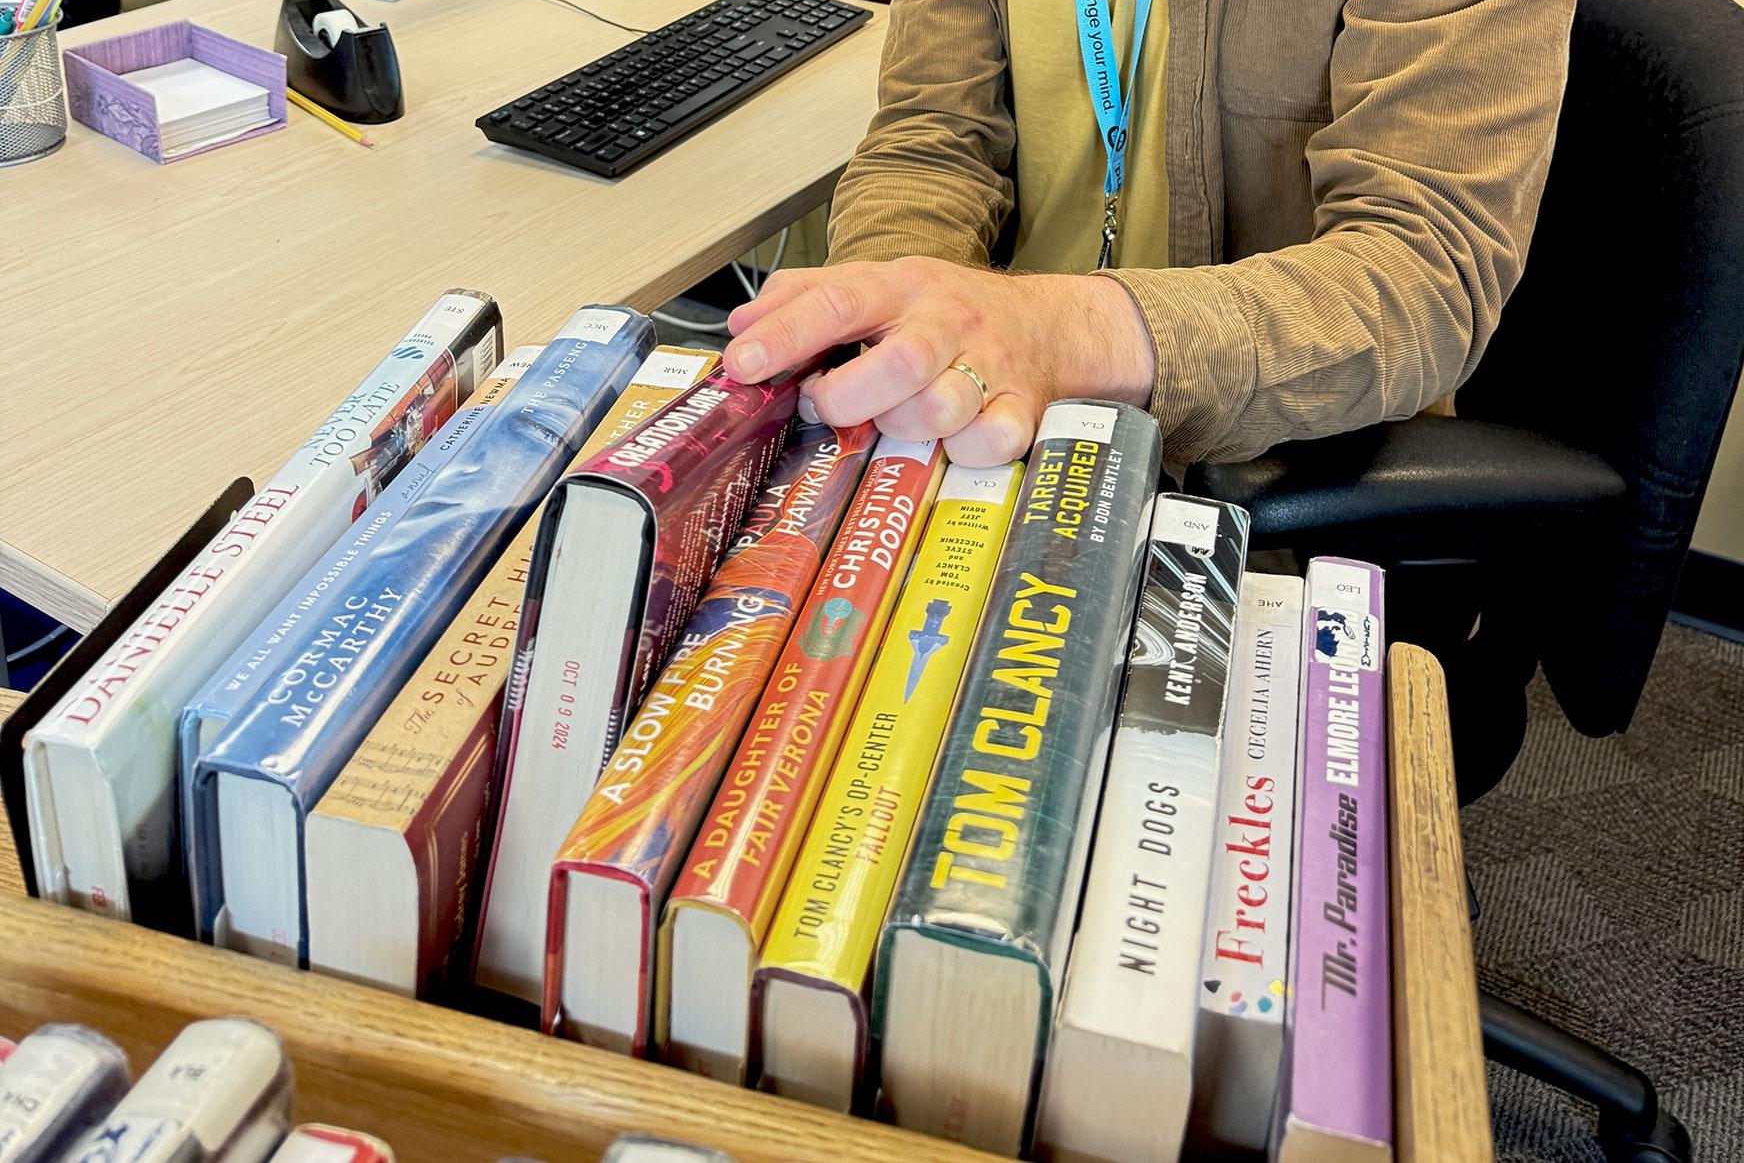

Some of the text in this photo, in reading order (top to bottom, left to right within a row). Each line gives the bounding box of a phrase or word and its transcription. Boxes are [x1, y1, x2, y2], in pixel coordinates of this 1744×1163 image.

[1087, 30, 1106, 69] your
[1097, 68, 1115, 115] mind.
[444, 305, 465, 314] STE
[583, 322, 608, 331] MCC
[520, 338, 592, 415] THE PASSENG
[663, 366, 689, 376] MAR
[302, 391, 367, 451] NEVER
[309, 381, 401, 468] TOO LATE
[440, 406, 484, 452] CATHERINE
[607, 410, 699, 467] CREATION
[675, 387, 731, 416] LAKE
[1081, 420, 1105, 430] CLA
[735, 483, 792, 548] PAULA
[777, 442, 842, 536] HAWKINS
[960, 505, 986, 513] ROVIN
[973, 479, 997, 488] CLA
[1023, 449, 1066, 525] TARGET
[1052, 440, 1099, 540] ACQUIRED
[1089, 448, 1124, 543] BY DON BENTLEY
[832, 462, 905, 589] CHRISTINA
[834, 534, 850, 558] TIMES
[870, 494, 914, 571] DODD
[939, 537, 985, 549] PIECZENIK
[945, 545, 973, 555] STEVE
[958, 520, 989, 531] Written
[1183, 519, 1211, 531] AND
[58, 484, 300, 725] DANIELLE STEEL
[226, 509, 393, 692] WE ALL WANT IMPOSSIBLE THINGS
[935, 561, 970, 572] CLANCY
[936, 579, 970, 592] Created
[940, 571, 959, 580] TOM
[1257, 598, 1283, 607] AHE
[1336, 582, 1362, 595] LEO
[267, 595, 369, 705] CORMAC
[421, 595, 510, 705] SECRET
[1173, 571, 1208, 656] ANDERSON
[562, 660, 581, 687] OCT
[663, 632, 710, 686] FIRE
[684, 594, 765, 712] BURNING
[1163, 659, 1196, 706] KENT
[613, 692, 678, 773] SLOW
[930, 571, 1078, 890] TOM CLANCY
[1246, 628, 1275, 760] CECELIA AHERN
[551, 721, 571, 750] 2024
[692, 661, 804, 880] A DAUGHTER OF
[1325, 696, 1361, 787] ELMORE
[599, 781, 632, 806] A
[741, 689, 831, 868] FAIR VERONA
[793, 712, 899, 939] TOM CLANCY'S OP-CENTER
[854, 785, 903, 865] FALLOUT
[1118, 781, 1180, 976] NIGHT DOGS
[1213, 775, 1276, 969] Freckles
[1321, 792, 1358, 1012] Mr. Paradise
